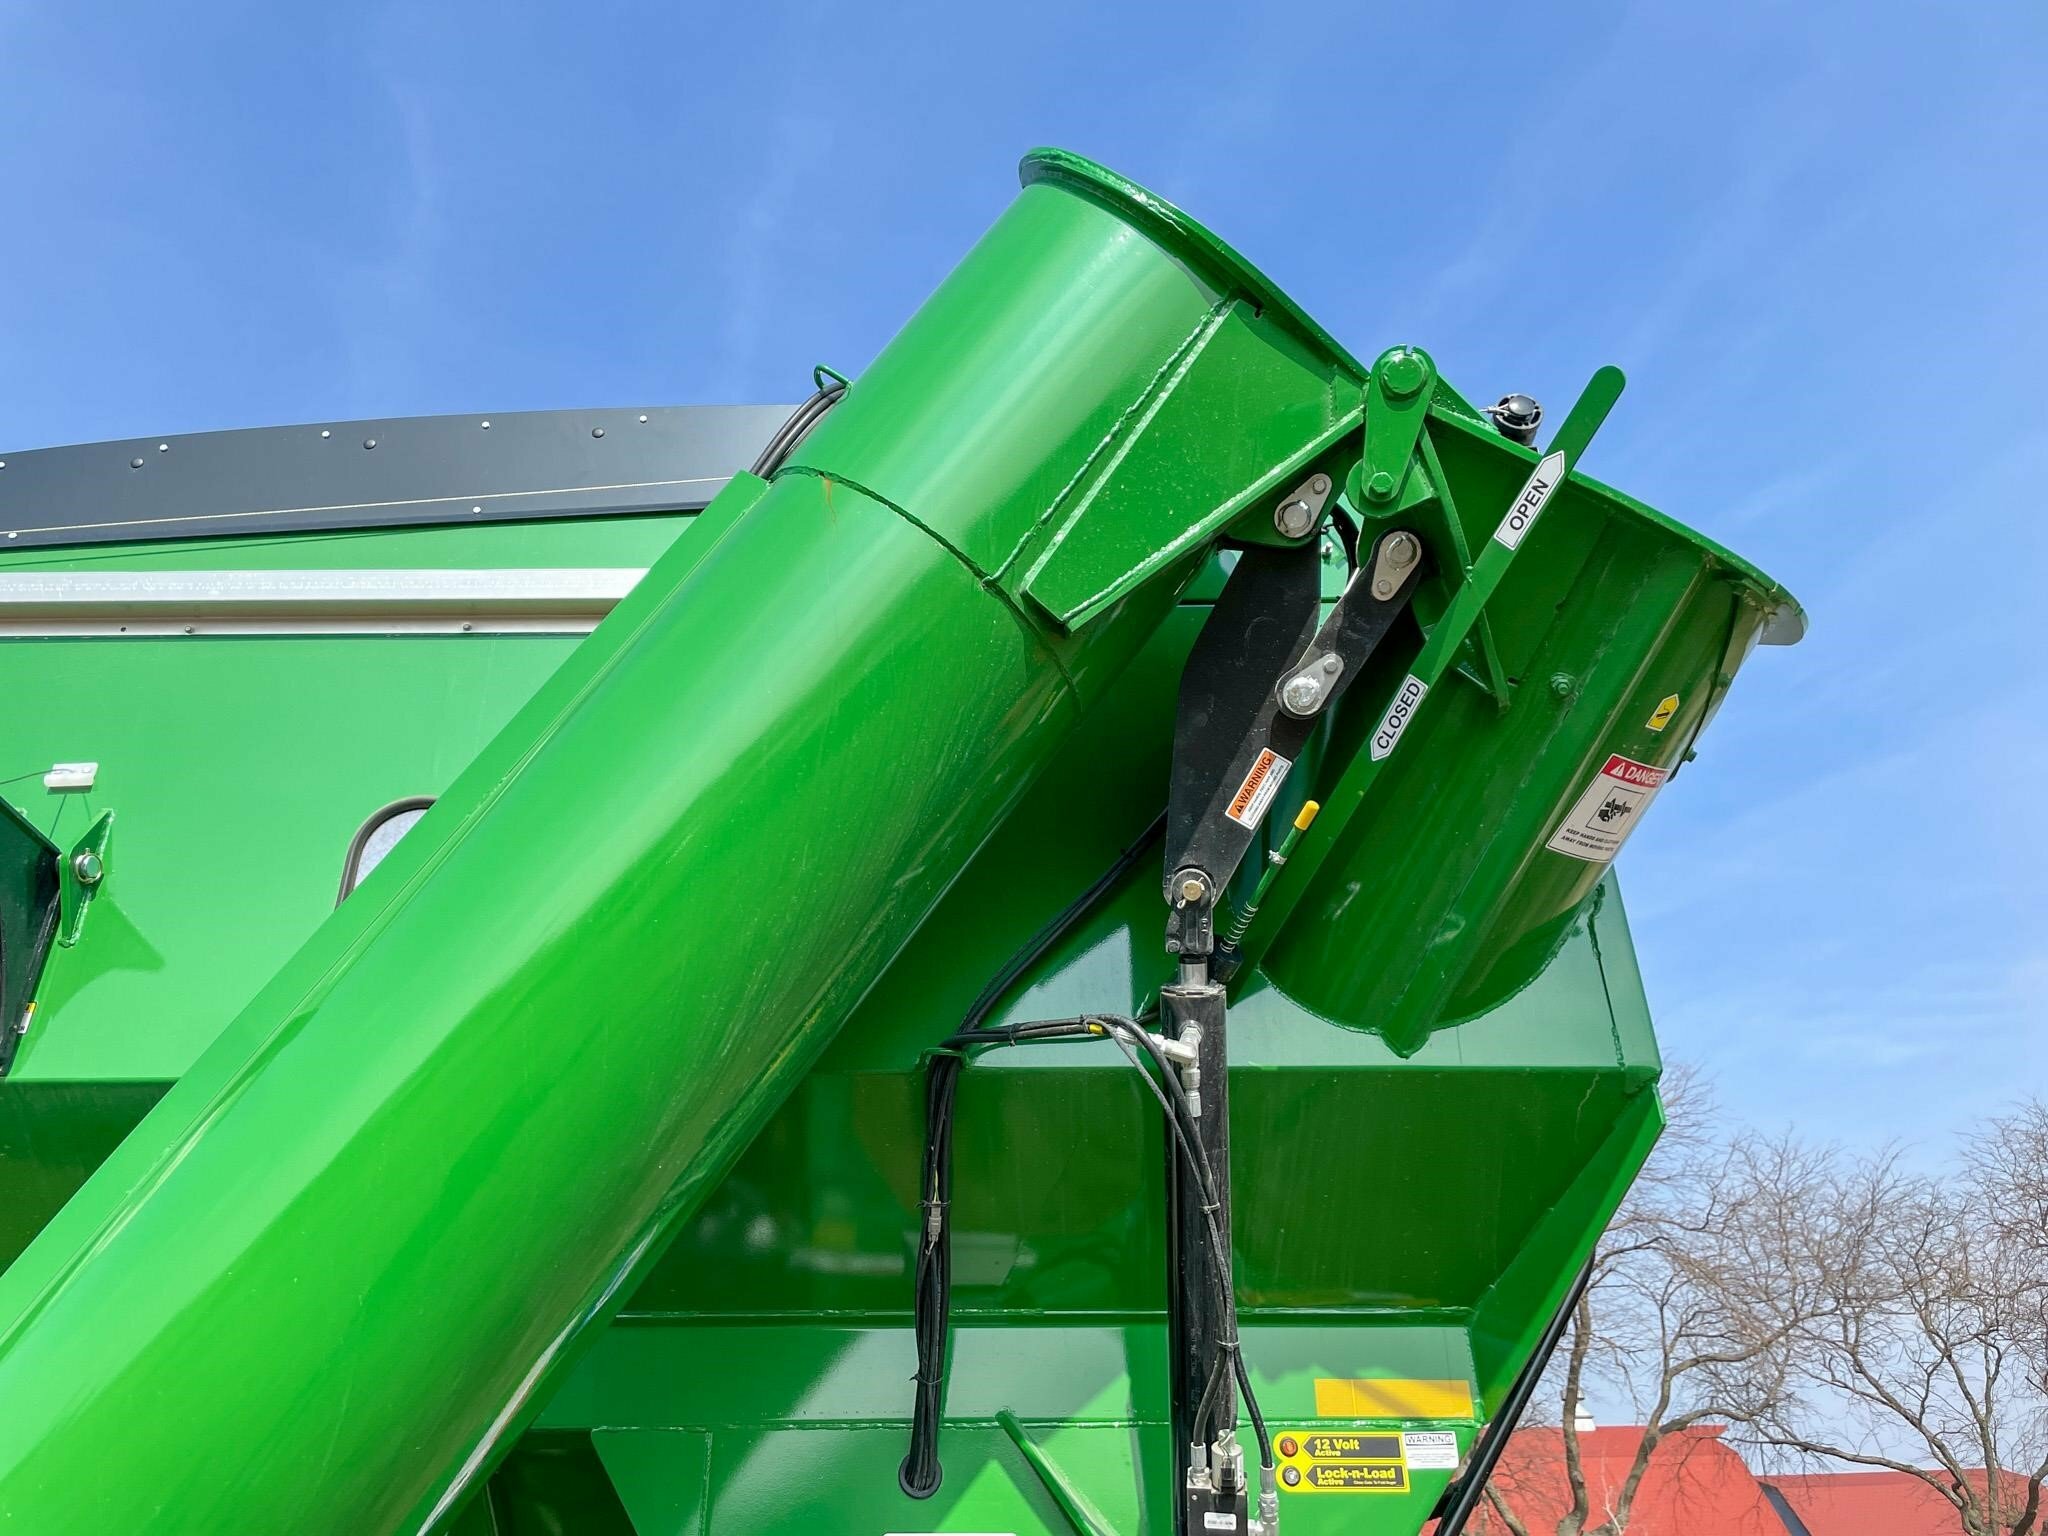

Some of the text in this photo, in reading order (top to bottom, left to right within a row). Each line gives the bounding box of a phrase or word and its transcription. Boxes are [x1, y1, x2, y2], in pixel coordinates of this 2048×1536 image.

[1509, 478, 1549, 531] OPEN
[1377, 682, 1421, 750] CLOSED
[1238, 756, 1272, 804] WARNING
[1314, 1438, 1360, 1450] 12 Volt
[1407, 1435, 1452, 1443] WARNING
[1314, 1449, 1341, 1457] Active
[1317, 1467, 1396, 1479] Lock-n-Load
[1317, 1478, 1345, 1486] Active
